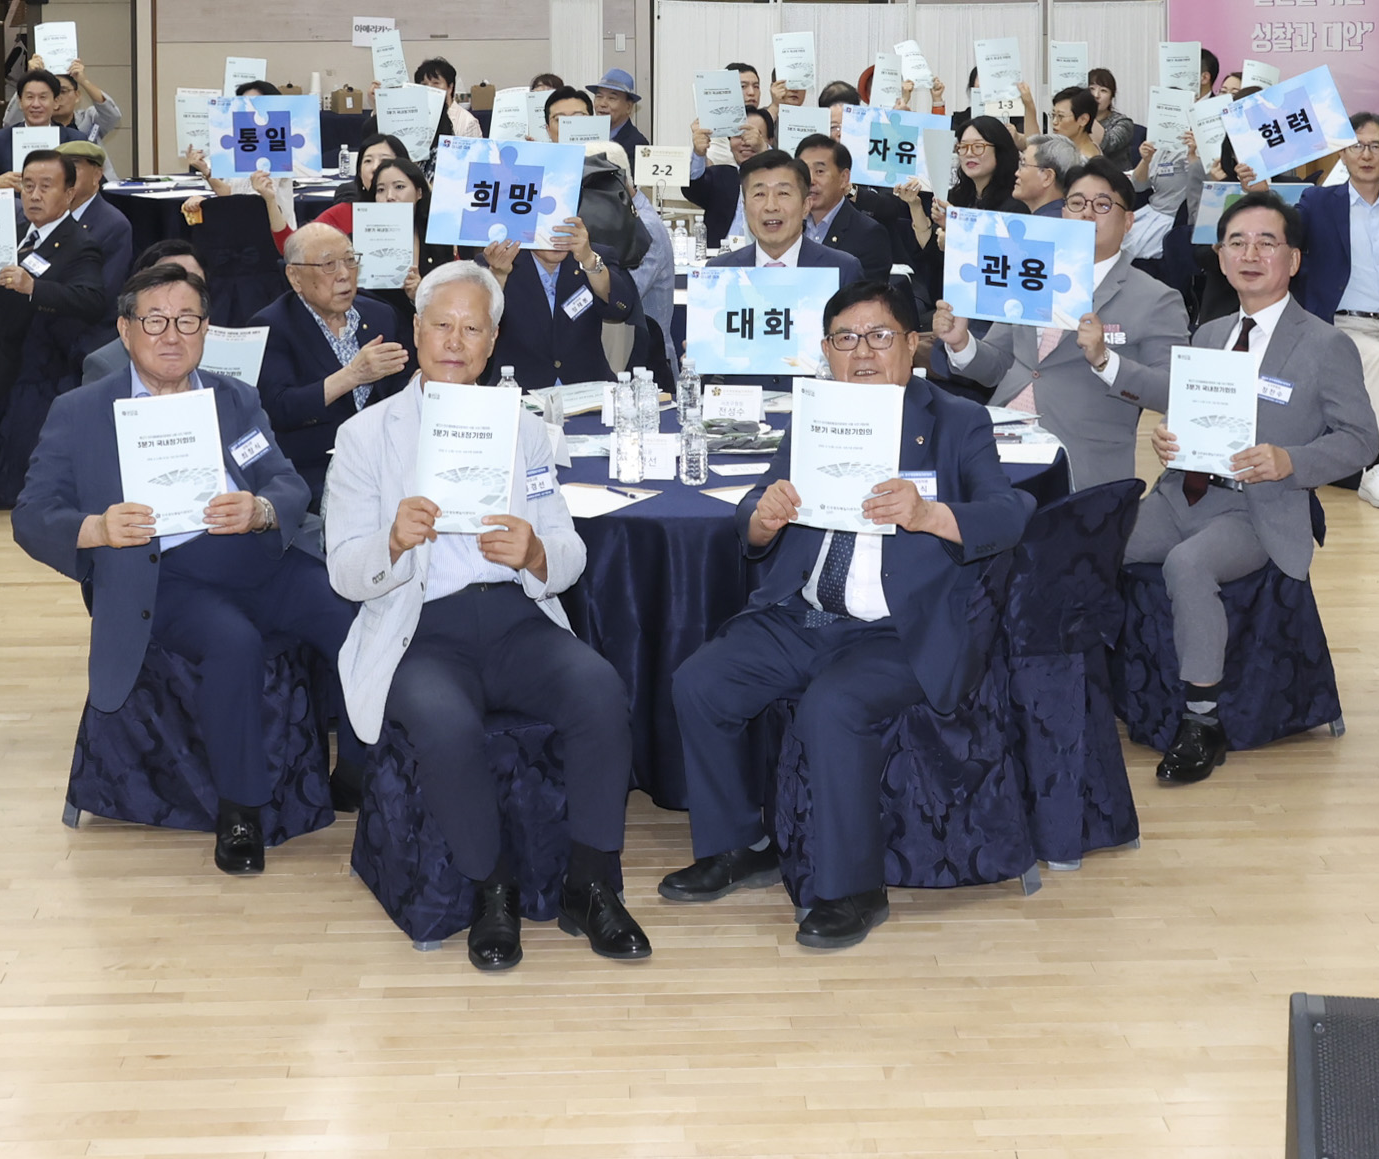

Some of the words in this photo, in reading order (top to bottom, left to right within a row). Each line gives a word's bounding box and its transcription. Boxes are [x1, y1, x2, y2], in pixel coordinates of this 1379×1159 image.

[1251, 22, 1317, 53] 성찰과
[997, 100, 1014, 110] 1-3
[237, 126, 287, 153] 통일
[1258, 108, 1313, 148] 협력
[868, 138, 917, 165] 자유
[651, 164, 673, 177] 2-2
[470, 180, 539, 216] 희망
[981, 255, 1048, 291] 관용
[725, 307, 794, 341] 대화
[433, 429, 449, 437] 3분기
[451, 430, 493, 440] 국내정기회의
[811, 425, 828, 434] 3분기
[830, 427, 873, 436] 국내정기회의
